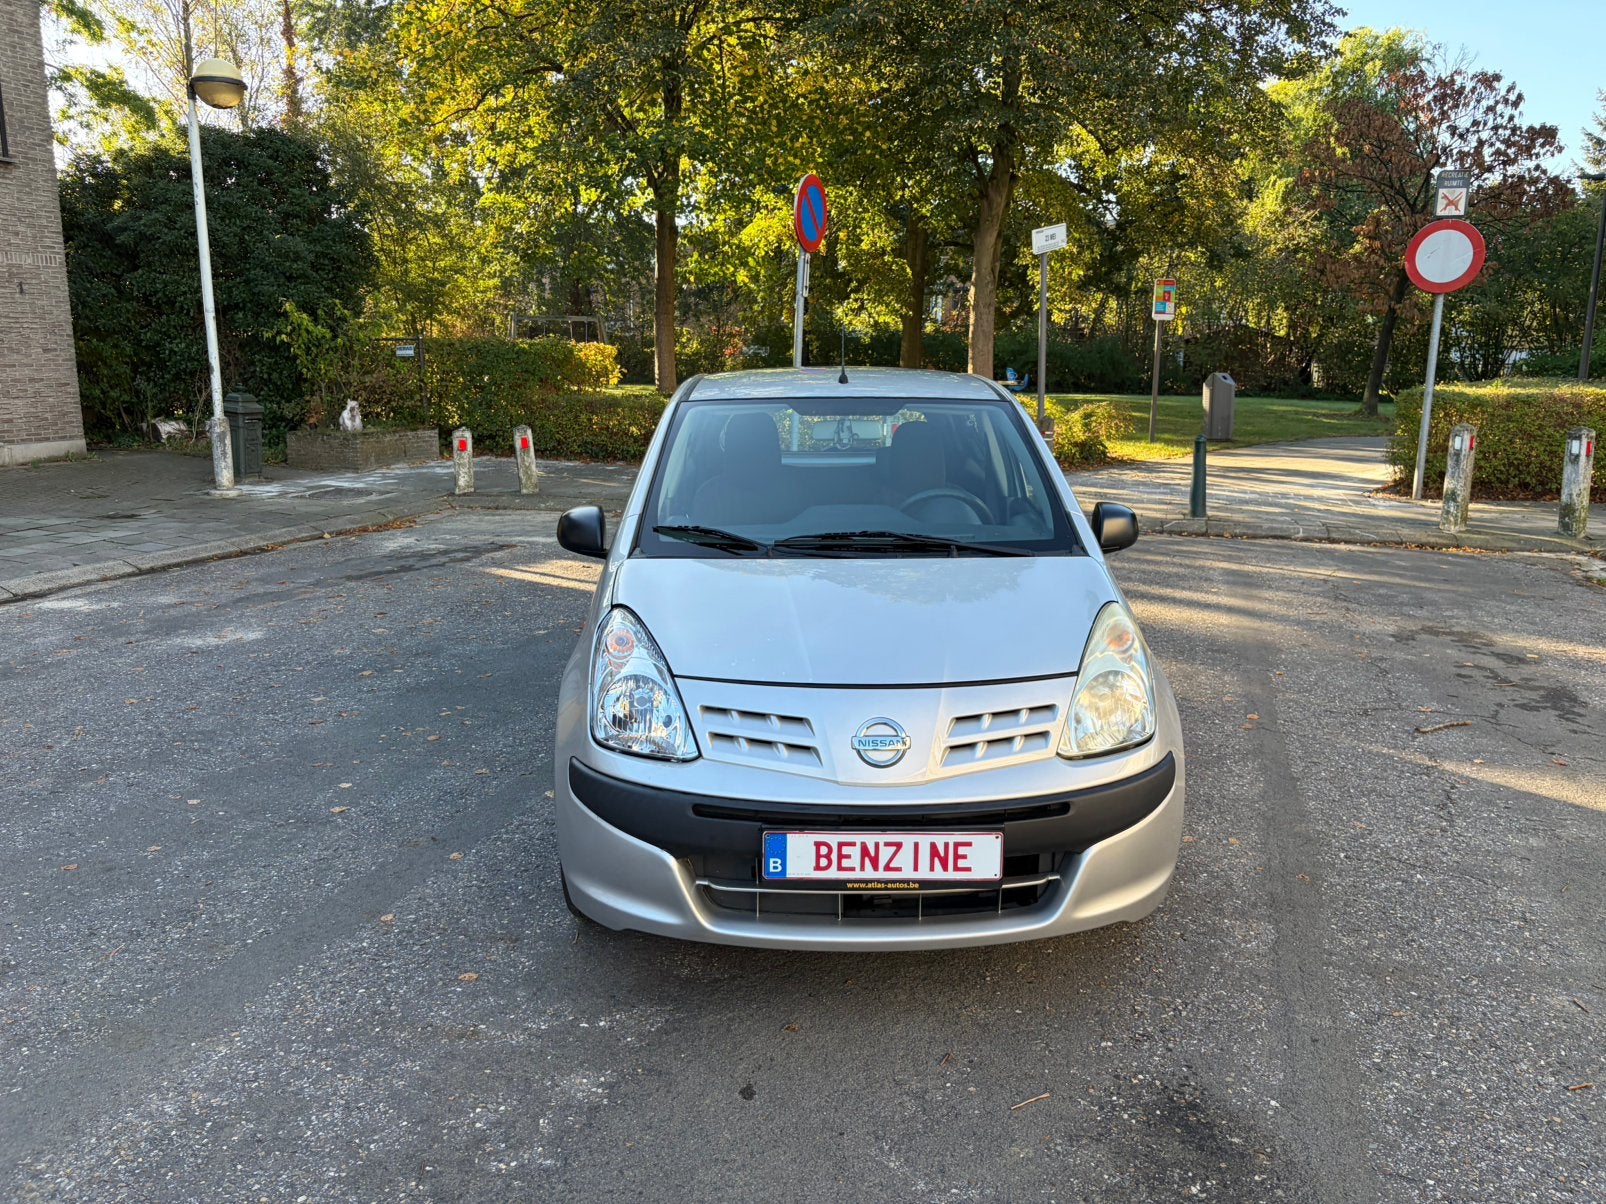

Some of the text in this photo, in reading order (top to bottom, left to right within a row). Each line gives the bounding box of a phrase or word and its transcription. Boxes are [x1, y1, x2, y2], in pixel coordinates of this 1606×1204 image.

[858, 739, 907, 747] NISSAN
[813, 841, 973, 873] BENZINE
[769, 858, 783, 873] B
[846, 881, 920, 889] www.atlas-autos.be
